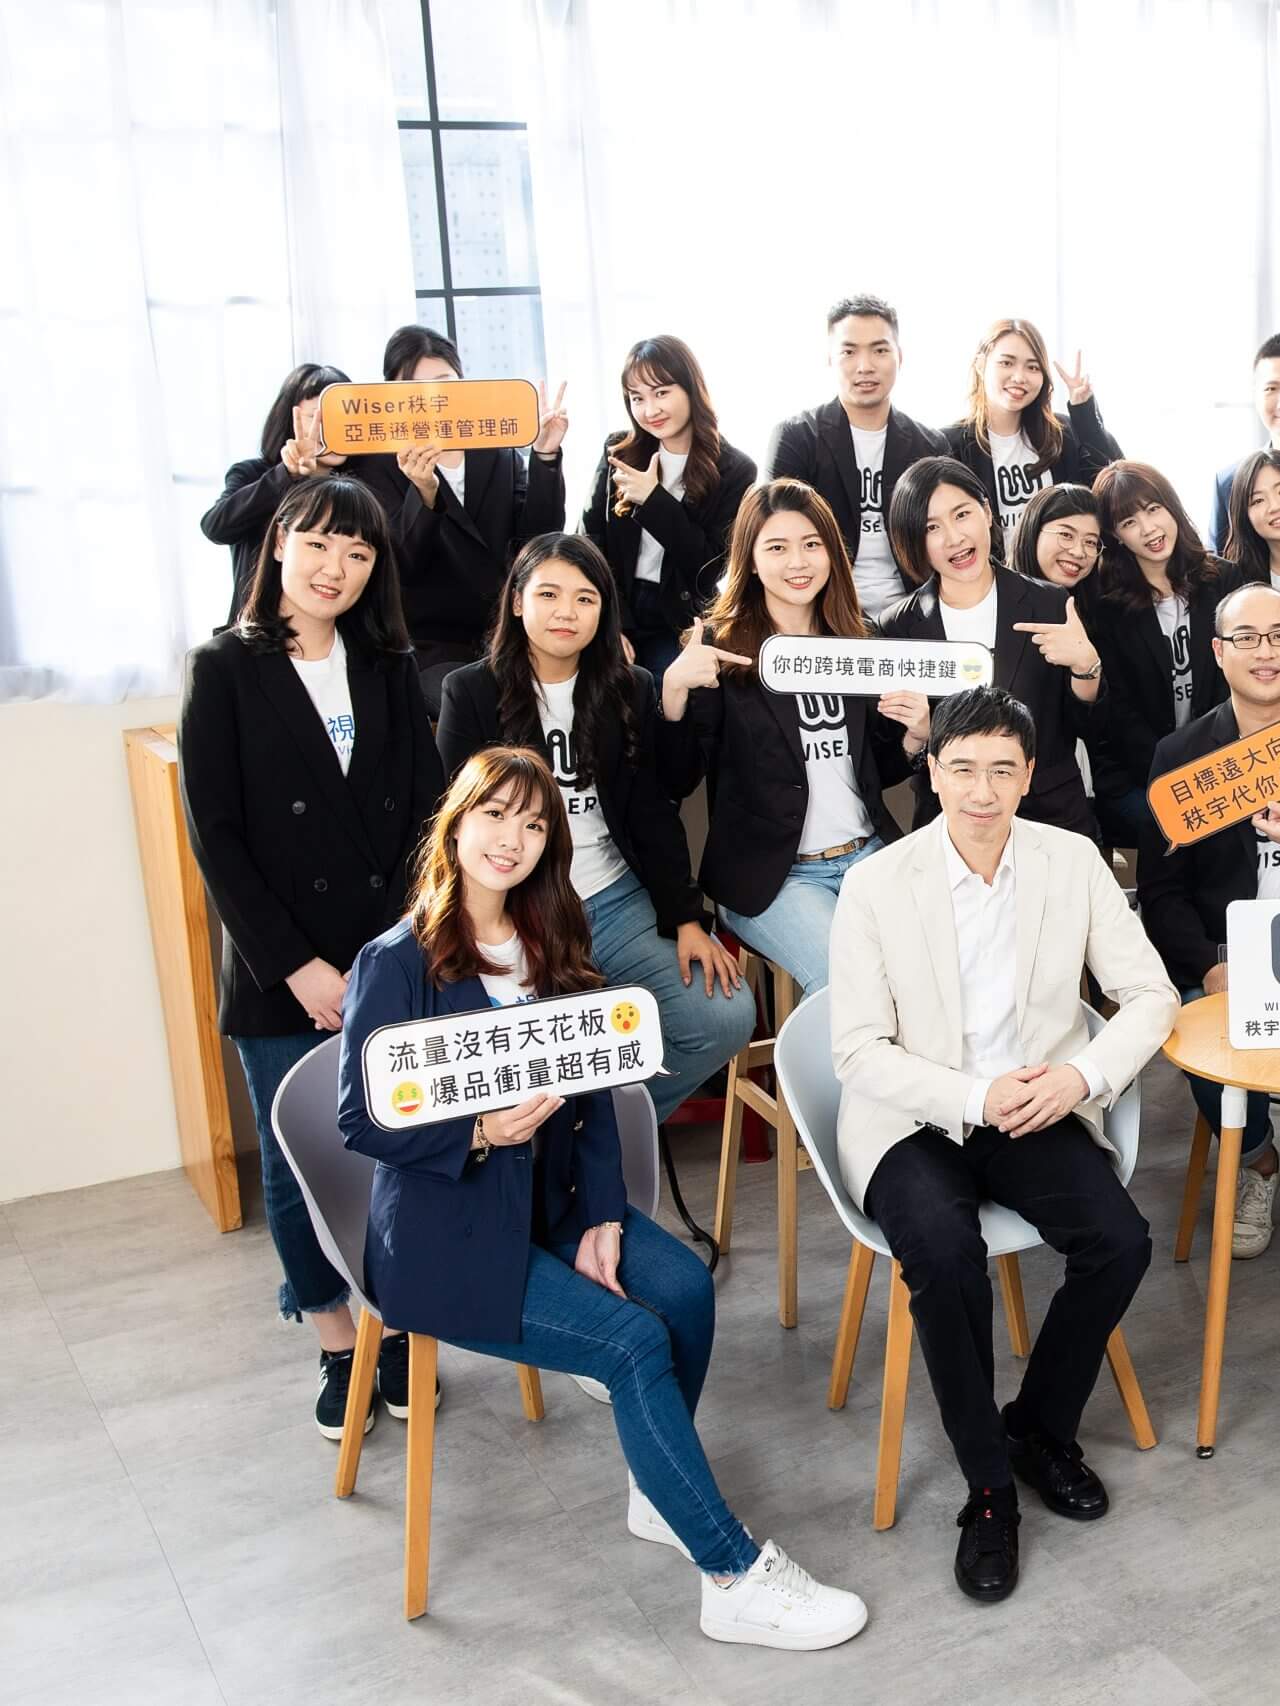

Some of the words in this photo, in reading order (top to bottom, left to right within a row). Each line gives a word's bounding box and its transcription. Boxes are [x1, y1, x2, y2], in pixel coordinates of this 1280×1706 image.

[341, 394, 450, 416] Wiser秩宇
[343, 417, 519, 443] 亞馬遜營運管理師
[772, 654, 958, 680] 你的跨境電商快捷鍵
[803, 739, 850, 762] ISE
[388, 1007, 608, 1074] 流量沒有天花板
[429, 1040, 645, 1109] 爆品衝量超有感
